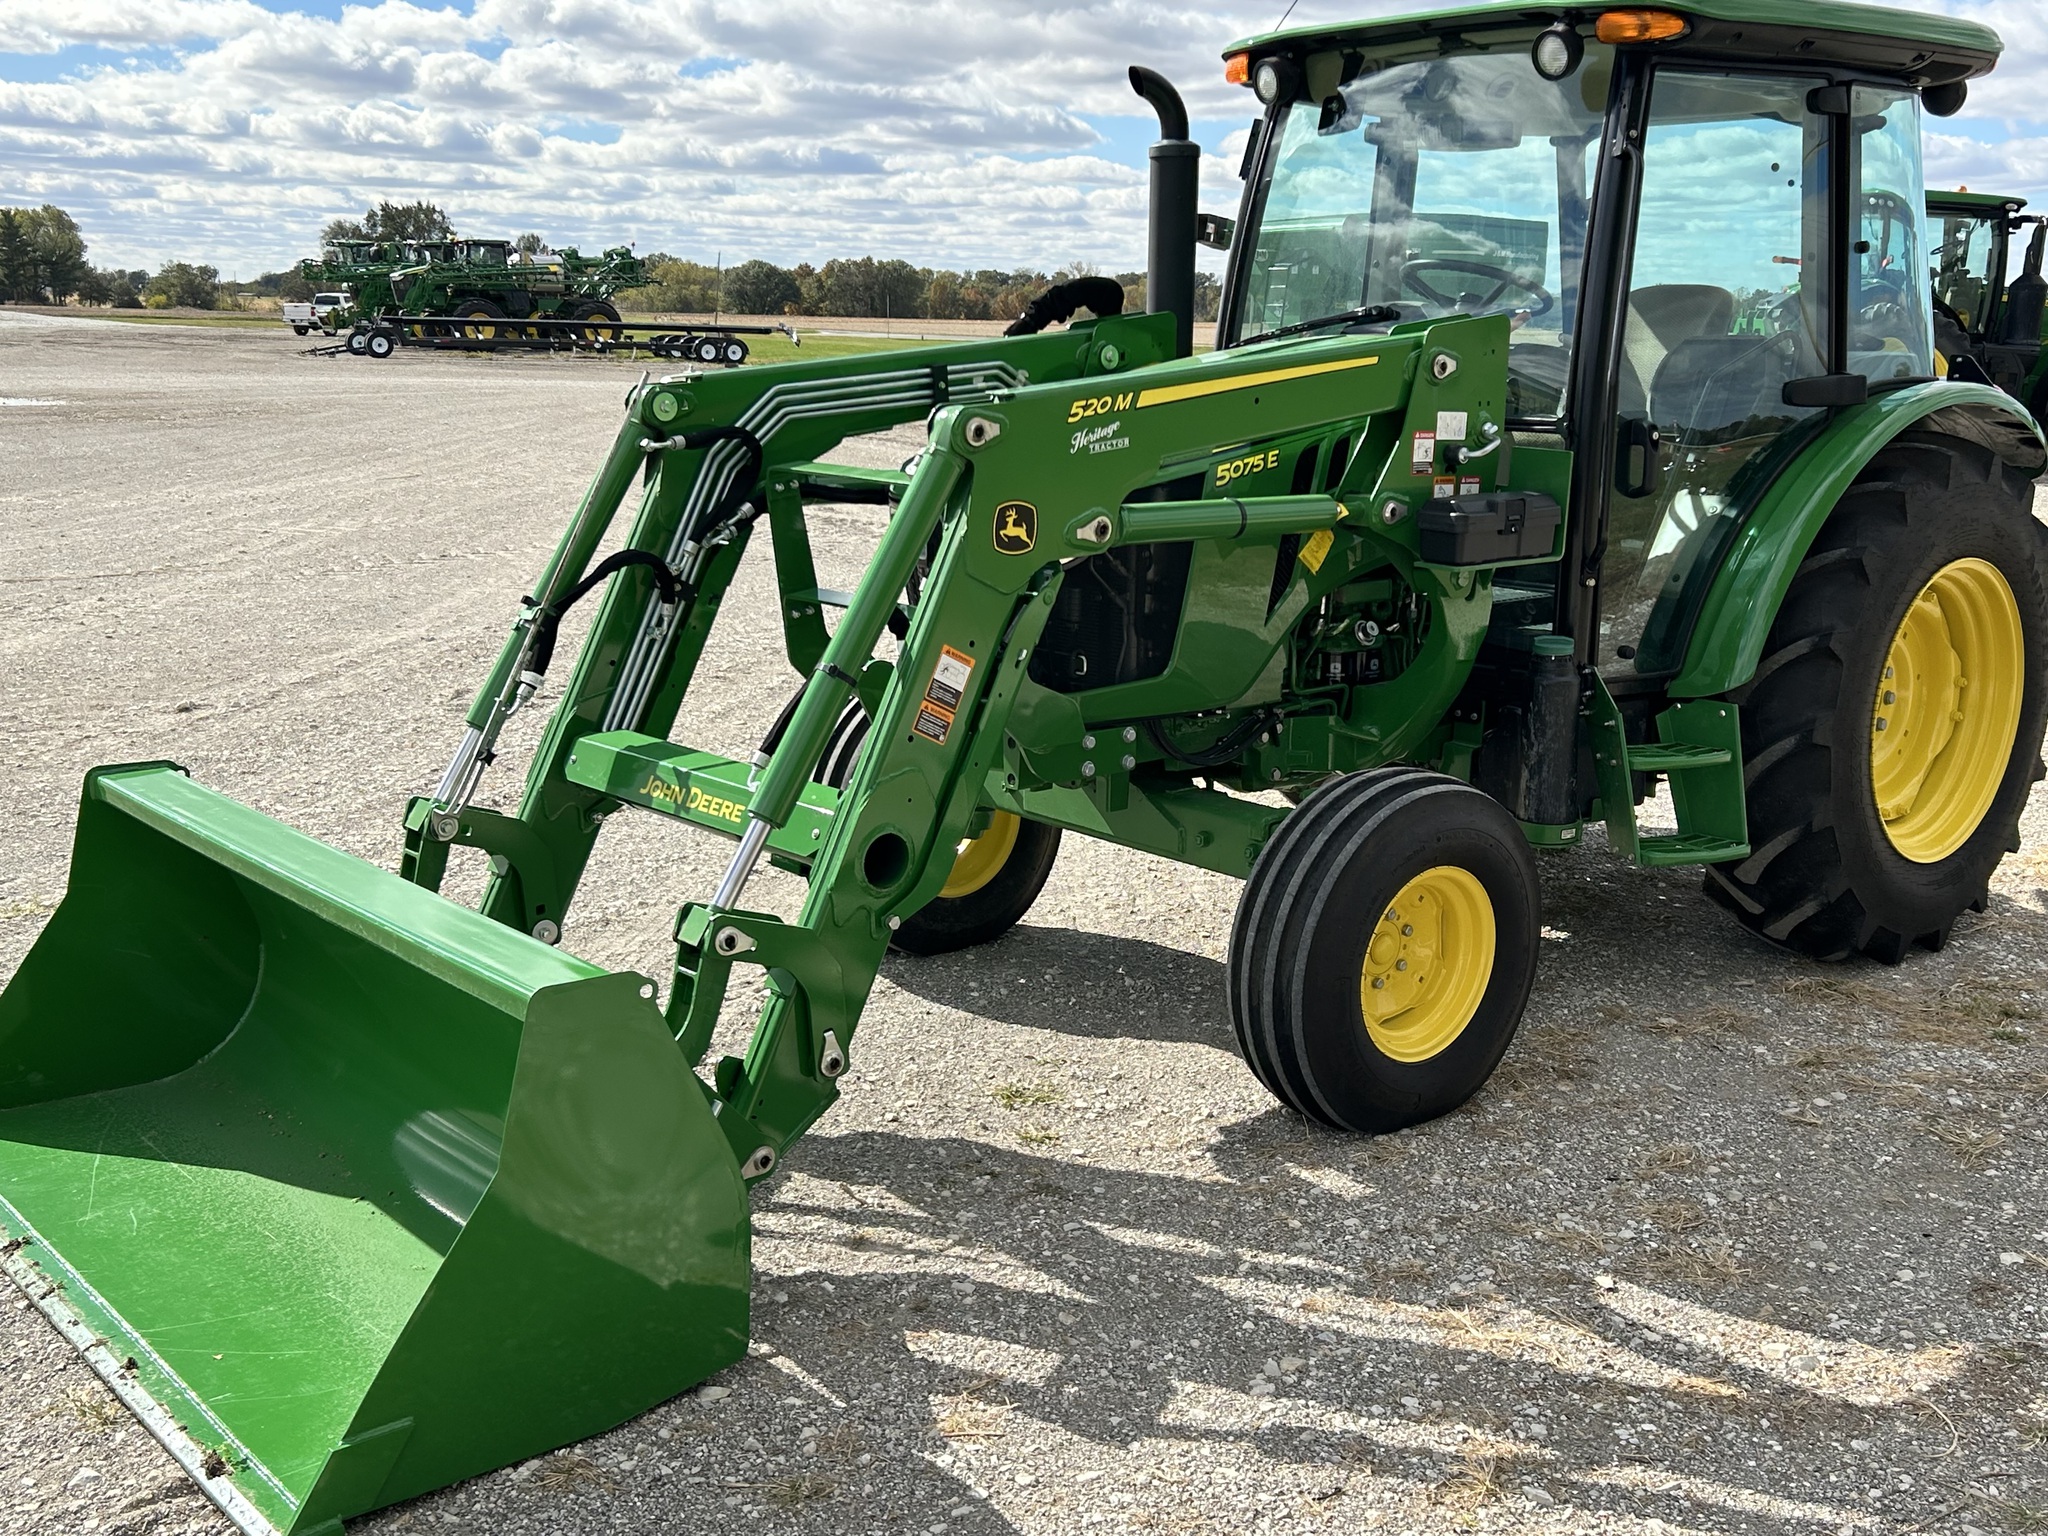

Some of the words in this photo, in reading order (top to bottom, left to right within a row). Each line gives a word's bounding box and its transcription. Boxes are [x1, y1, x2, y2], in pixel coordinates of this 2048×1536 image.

[1067, 395, 1112, 424] 520
[1070, 420, 1121, 454] Heritage
[1089, 437, 1130, 454] TRACTOR
[1215, 453, 1265, 487] 5075
[639, 775, 687, 805] JOHN
[686, 786, 746, 824] DEERE
